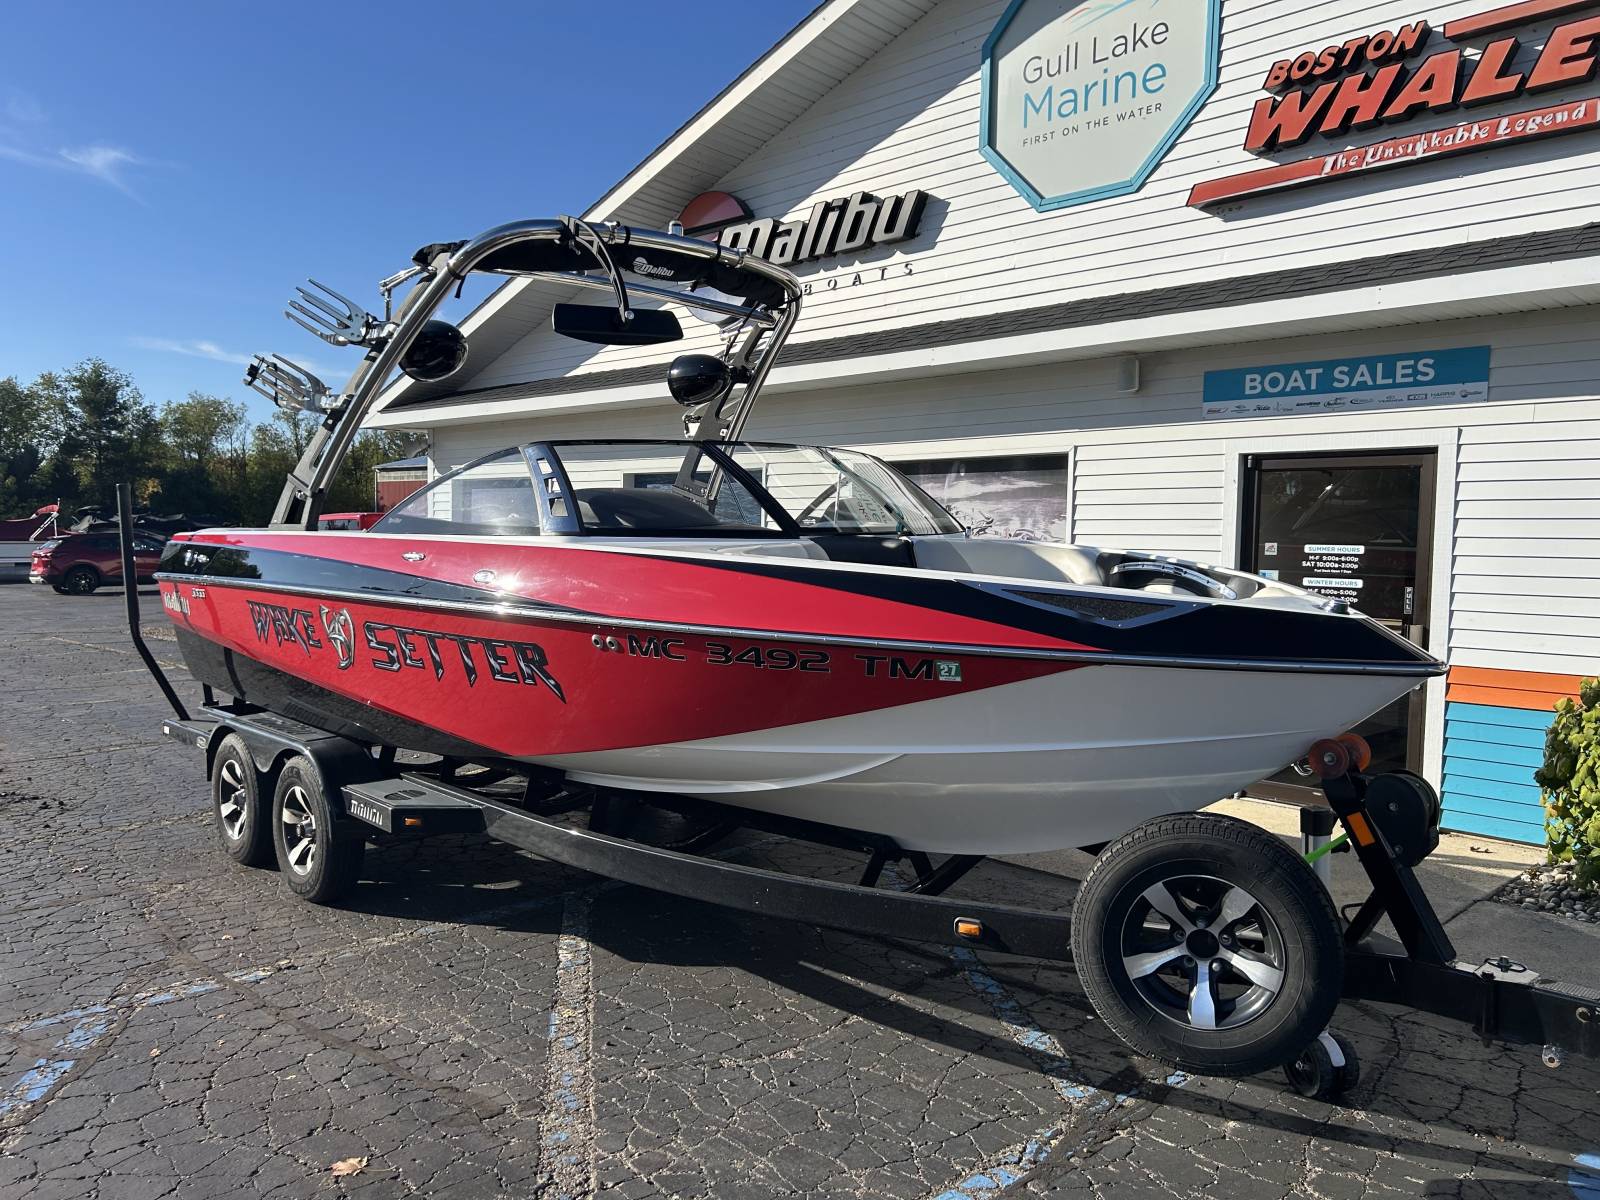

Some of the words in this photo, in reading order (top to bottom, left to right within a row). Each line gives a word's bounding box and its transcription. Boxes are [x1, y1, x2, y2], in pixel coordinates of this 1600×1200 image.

[1023, 42, 1079, 84] Gull
[1092, 21, 1169, 64] Lake
[1263, 20, 1431, 91] BOSTON
[1023, 62, 1167, 129] Marine
[1023, 131, 1056, 148] FIRST
[1062, 125, 1079, 137] ON
[1086, 116, 1110, 131] THE
[1116, 102, 1163, 122] WATER
[1321, 154, 1358, 177] The
[1362, 123, 1491, 168] Unsinkable
[1497, 101, 1587, 138] Legend
[802, 263, 914, 296] BOATS
[1244, 367, 1323, 396] BOAT
[1332, 357, 1435, 390] SALES
[246, 600, 322, 658] WAKE
[363, 620, 567, 704] SETTER
[627, 633, 686, 661] MC
[706, 641, 831, 673] 3492
[855, 654, 934, 681] TM
[940, 664, 956, 676] 27
